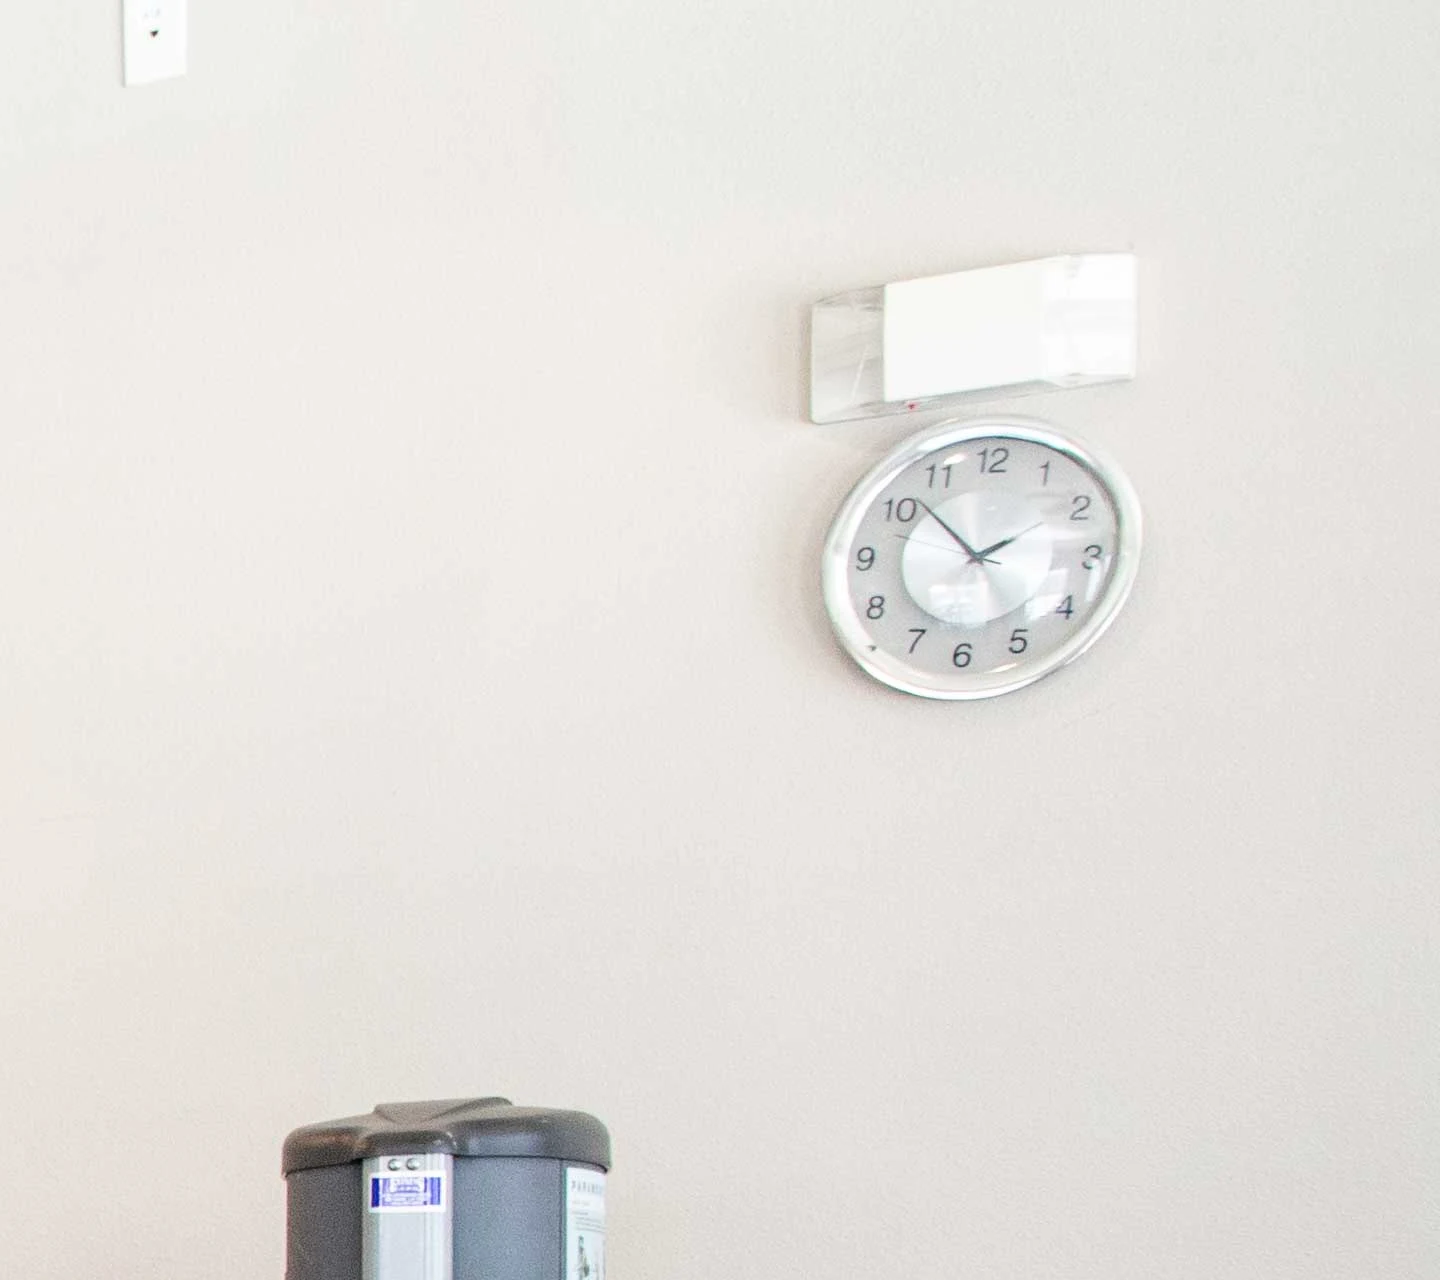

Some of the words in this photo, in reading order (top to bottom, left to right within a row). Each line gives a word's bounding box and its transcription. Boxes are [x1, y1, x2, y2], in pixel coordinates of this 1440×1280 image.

[977, 447, 1010, 473] 12
[1040, 460, 1051, 486] 1
[926, 464, 953, 489] 11
[883, 498, 918, 522] 10
[1070, 495, 1091, 521] 2
[856, 546, 876, 571] 9
[1081, 544, 1102, 571] 3
[866, 595, 885, 620] 8
[1055, 594, 1074, 620] 4
[908, 628, 927, 654] 7
[1008, 628, 1029, 654] 5
[952, 643, 973, 668] 6
